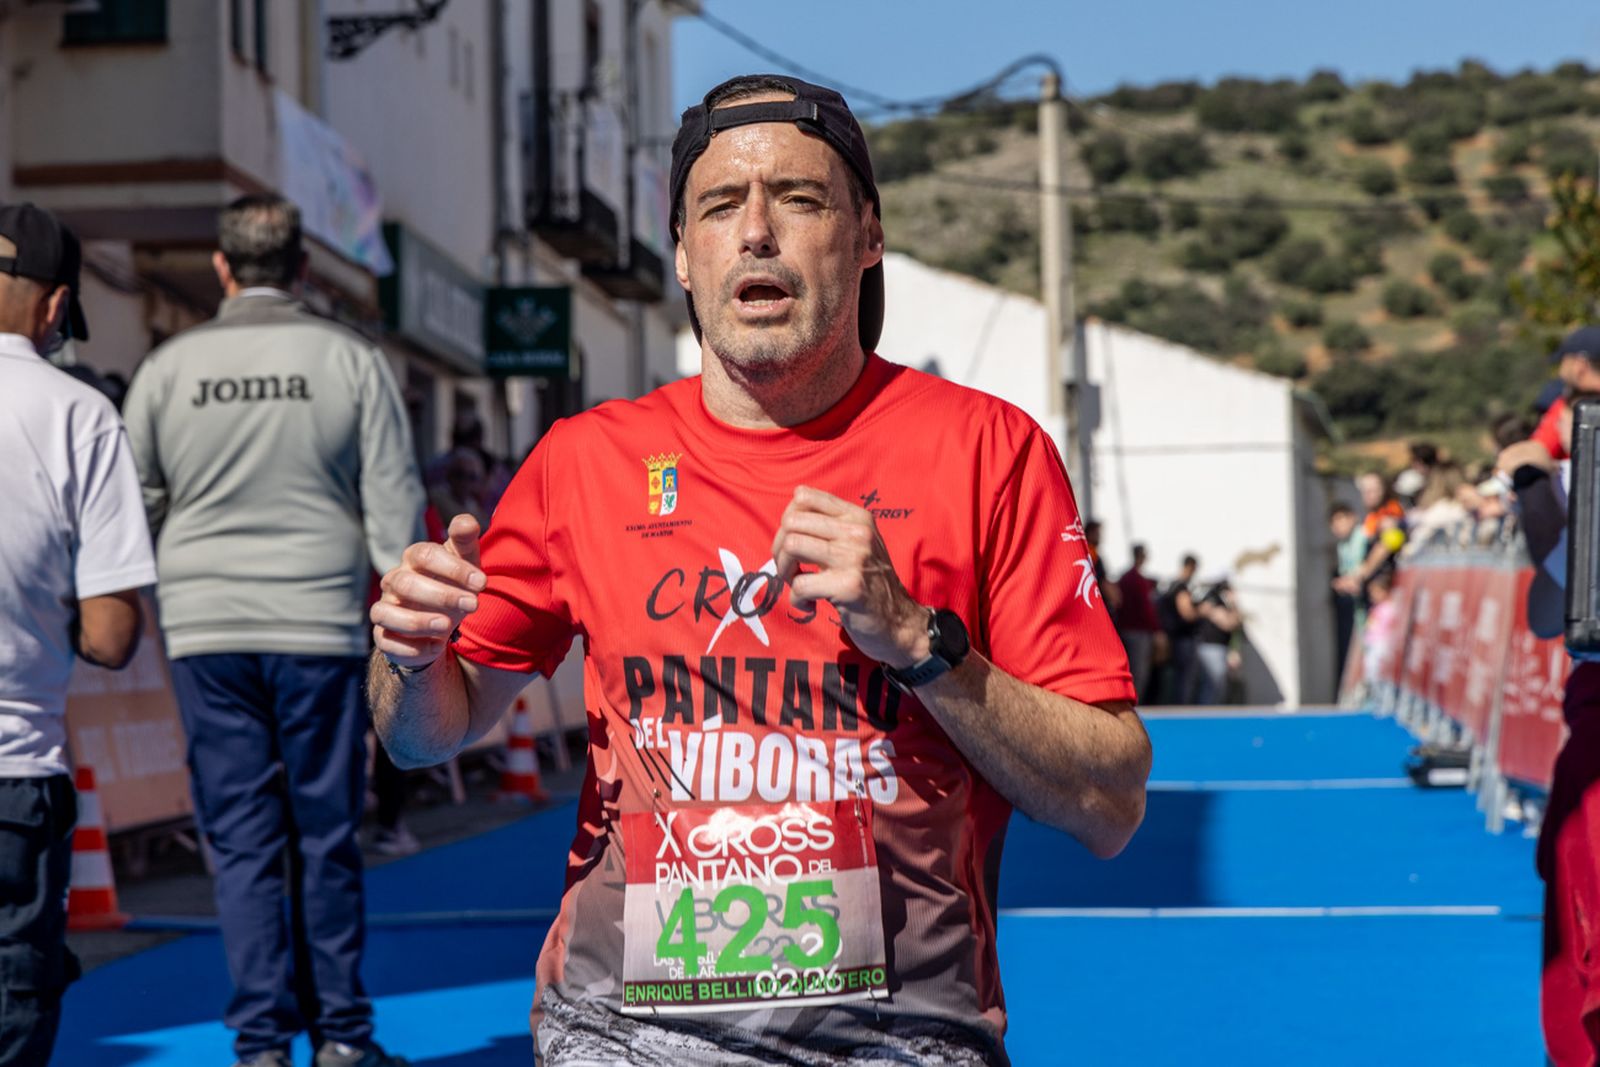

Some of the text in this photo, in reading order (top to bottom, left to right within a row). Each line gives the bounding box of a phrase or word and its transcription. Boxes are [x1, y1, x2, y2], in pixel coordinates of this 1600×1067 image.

[623, 655, 900, 732] PANTANO
[629, 717, 669, 749] DEL
[667, 714, 899, 806] VÍBORAS
[655, 811, 682, 858] X
[687, 816, 836, 858] CROSS
[655, 854, 838, 893] PANTANO DEL
[656, 880, 841, 977] 425
[625, 968, 886, 1003] ENRIQUE BELLIDO QUINTERO
